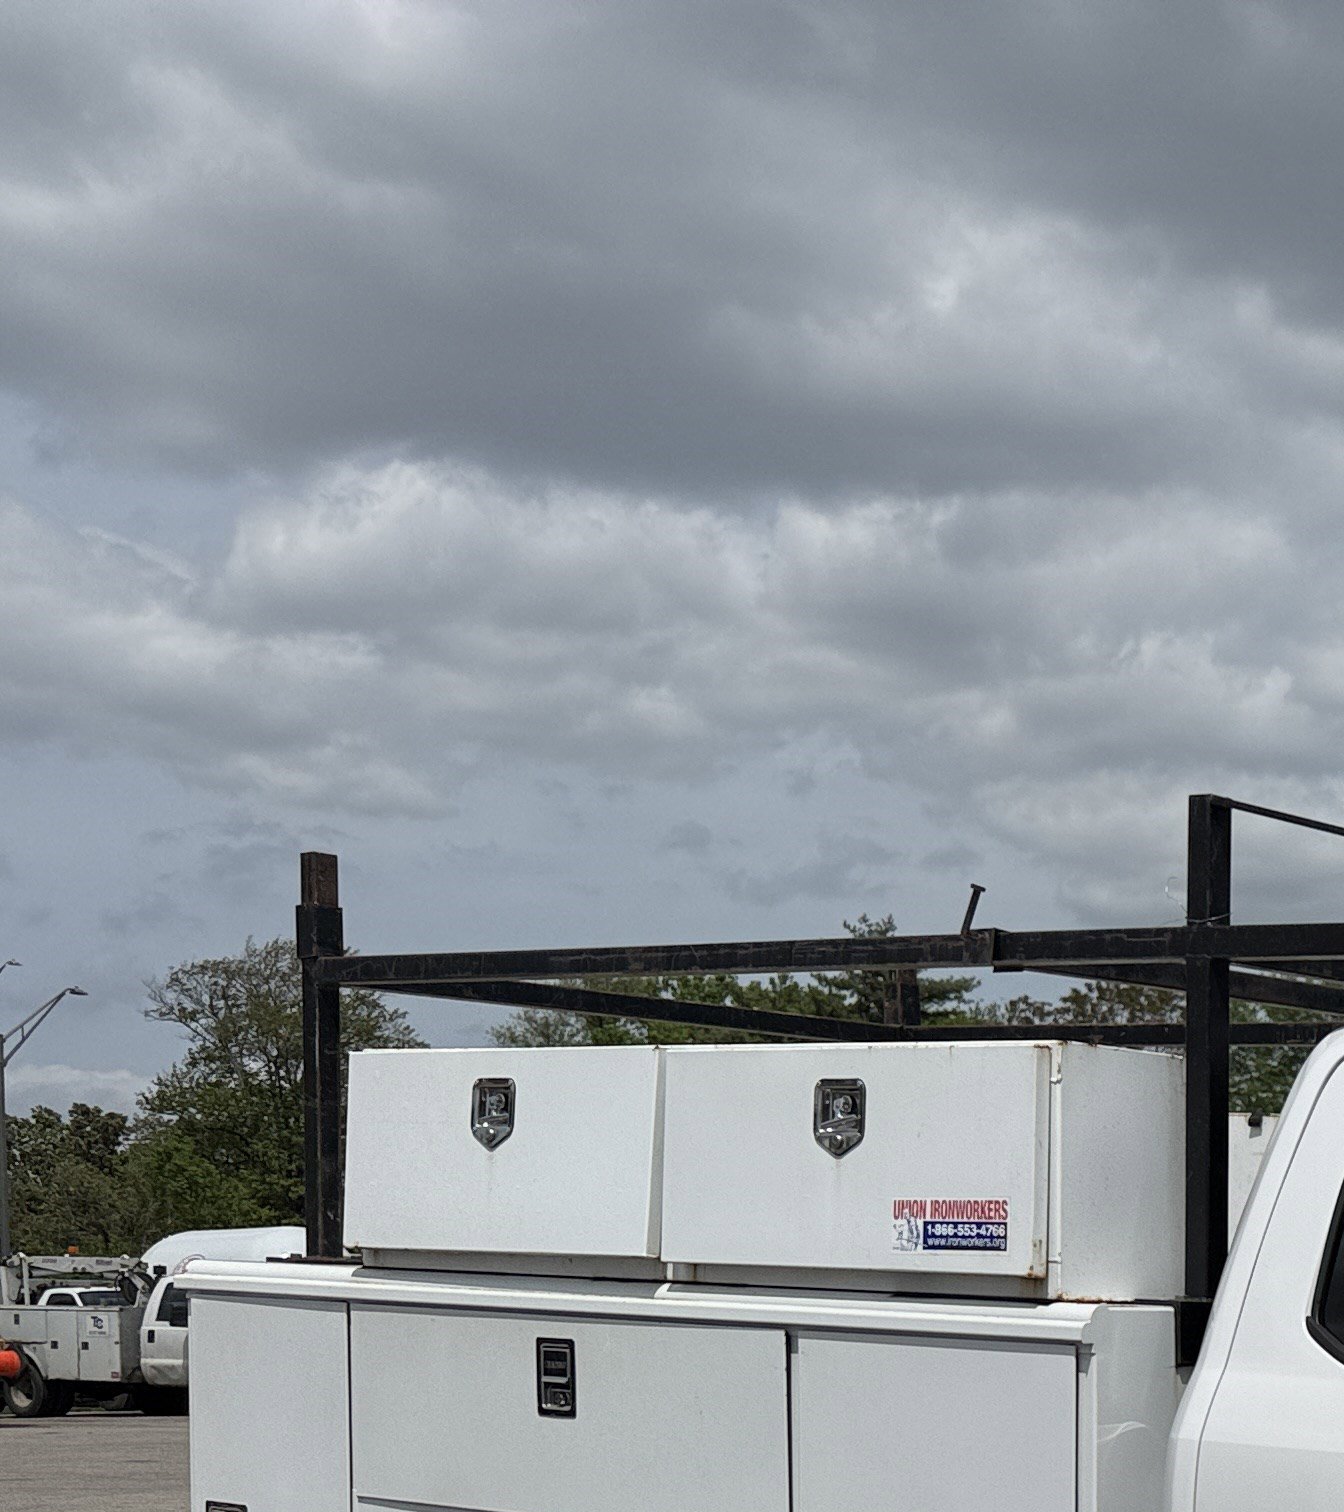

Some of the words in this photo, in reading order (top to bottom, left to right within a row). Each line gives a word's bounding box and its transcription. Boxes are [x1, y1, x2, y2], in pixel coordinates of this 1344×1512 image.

[893, 1199, 927, 1221] UNION
[929, 1199, 1009, 1221] IRONWORKERS
[926, 1223, 1006, 1237] 1-866-553-4766
[926, 1236, 1006, 1250] www.ironworkers.org
